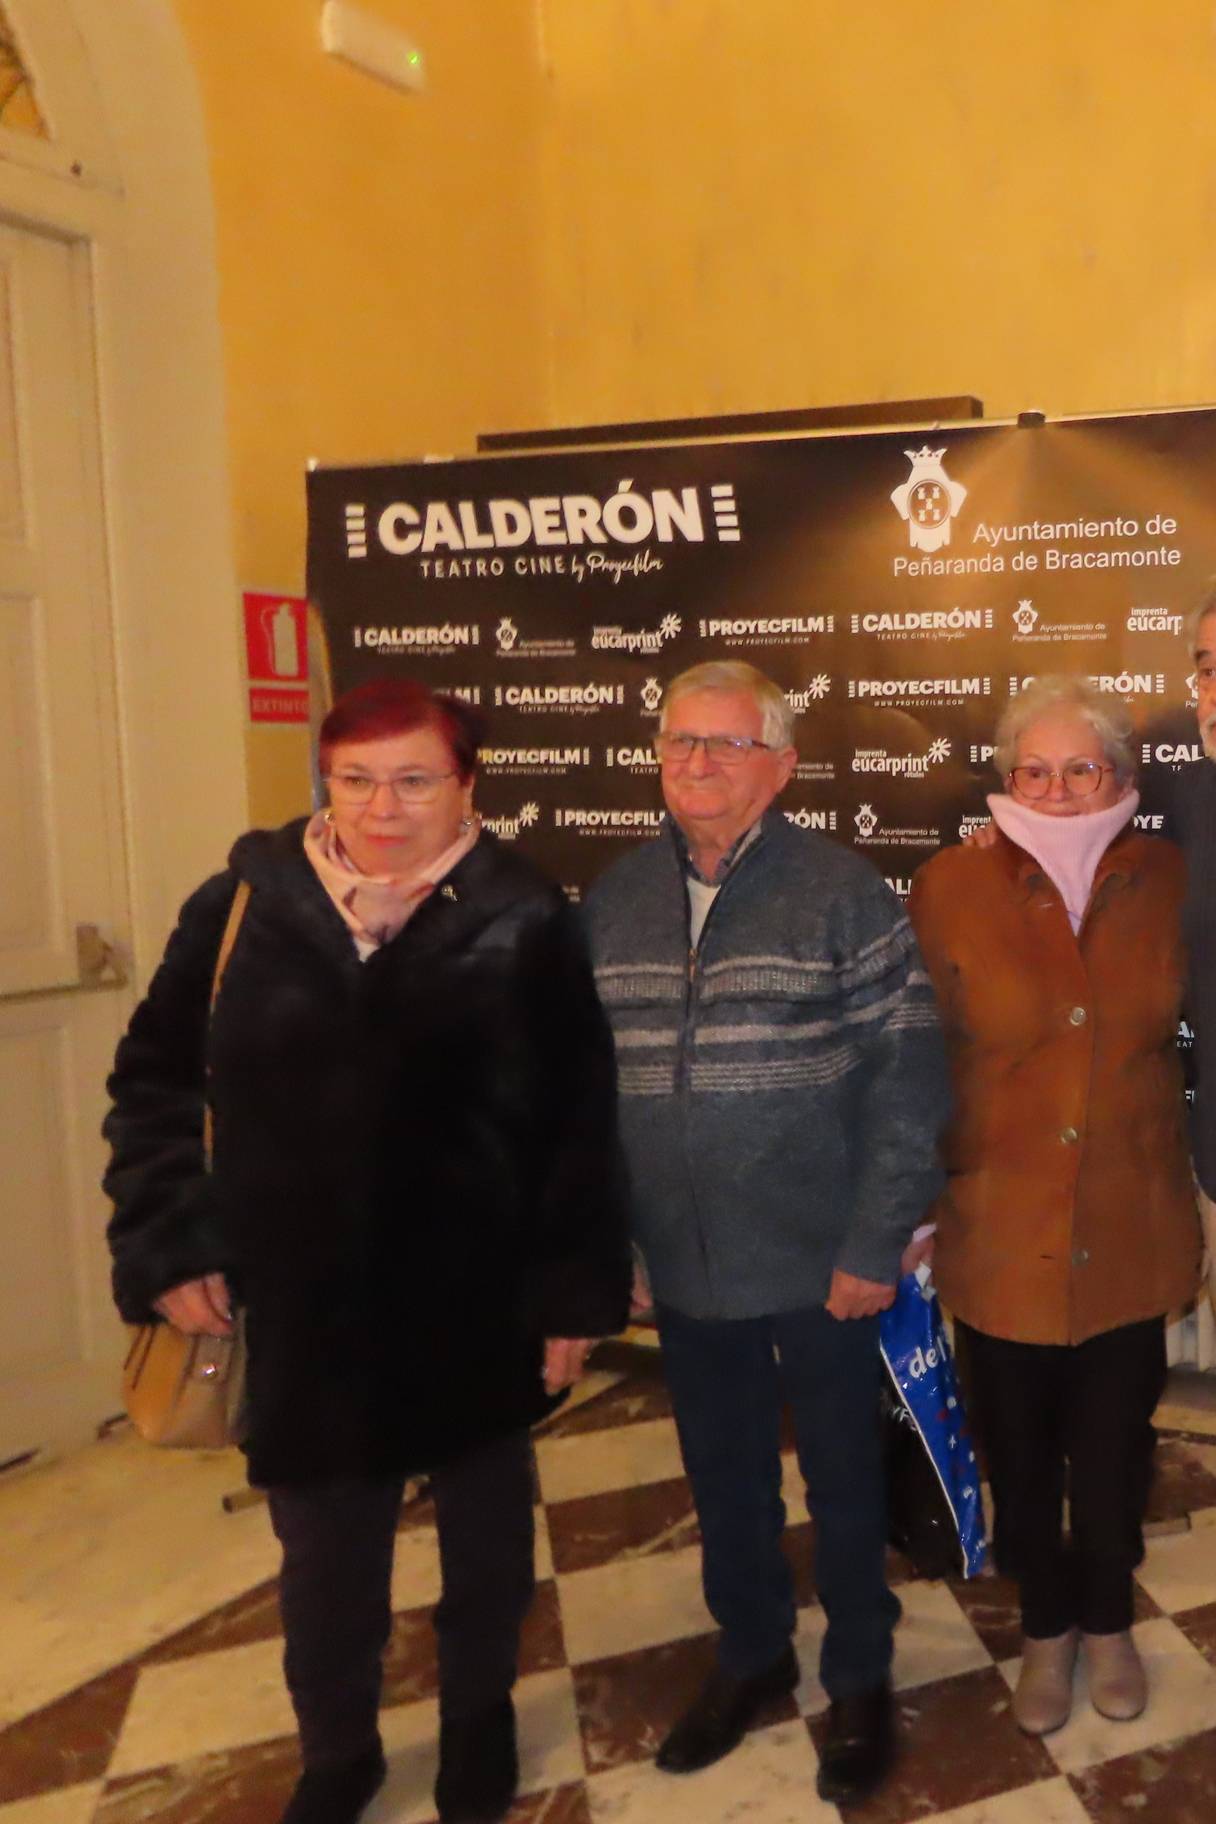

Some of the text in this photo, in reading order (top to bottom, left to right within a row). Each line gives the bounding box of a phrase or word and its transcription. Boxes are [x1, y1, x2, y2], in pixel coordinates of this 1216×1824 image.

[377, 478, 705, 557] CALDERÓN
[972, 514, 1177, 547] Ayuntamiento de
[420, 558, 504, 579] TEATRO
[514, 554, 566, 575] CINE
[893, 546, 1181, 577] Peñaranda de Bracamonte
[861, 606, 982, 633] CALDERÓN
[1130, 607, 1168, 618] imprenta
[364, 621, 470, 648] CALDERÓN
[709, 615, 825, 637] PROYECFILM
[1127, 615, 1183, 636] eucarp
[591, 627, 664, 653] eucarprint
[505, 681, 615, 706] CALDERÓN
[858, 677, 980, 698] PROYECFILM
[851, 753, 929, 777] eucarprint
[855, 748, 887, 759] imprenta
[962, 814, 992, 825] imprent
